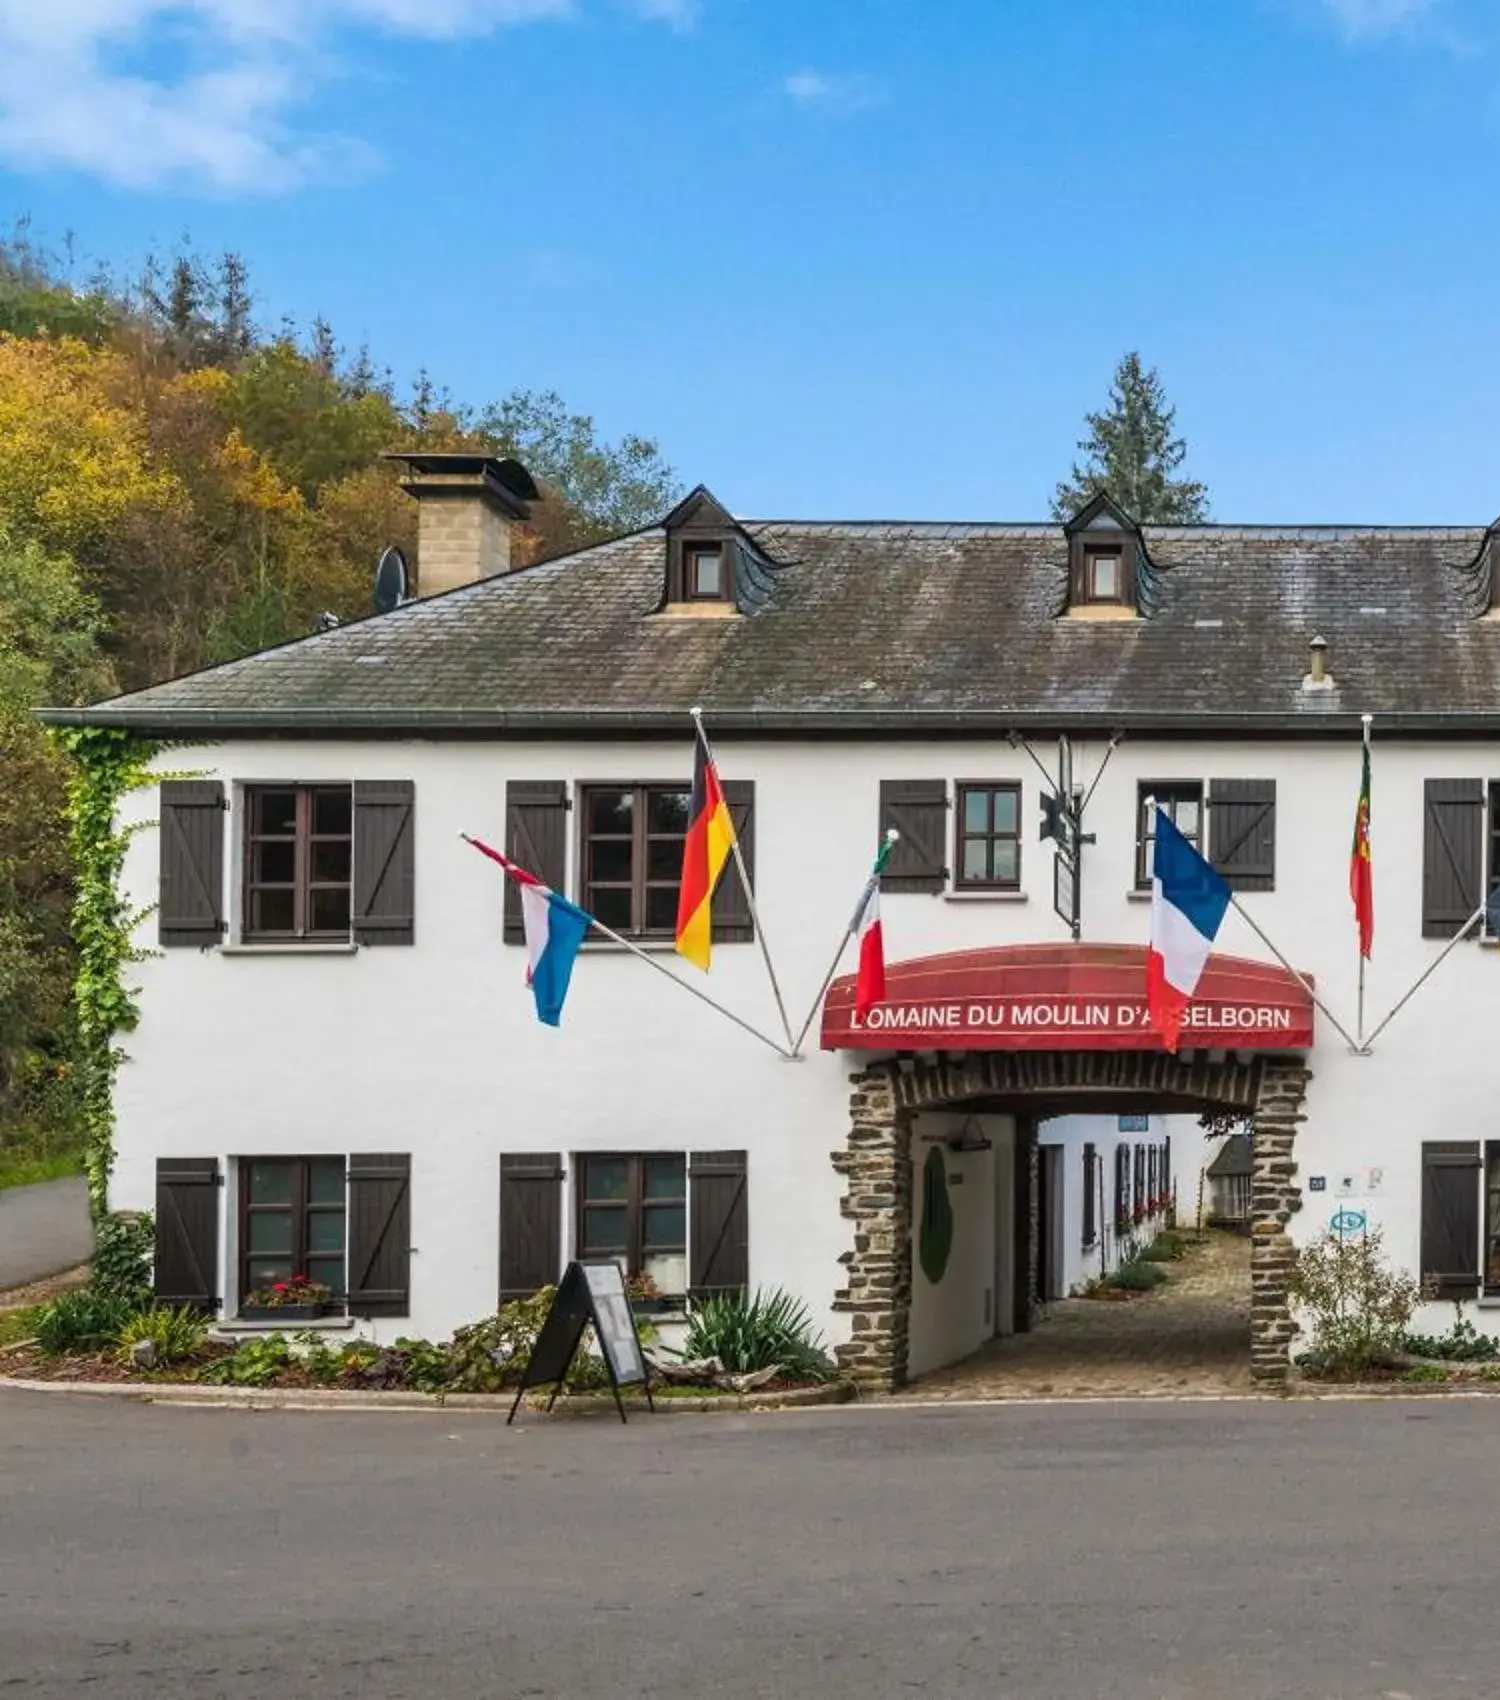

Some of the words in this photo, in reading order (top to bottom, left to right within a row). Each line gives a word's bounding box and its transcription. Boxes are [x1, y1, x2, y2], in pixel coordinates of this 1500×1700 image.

[967, 1005, 1004, 1025] DU
[1011, 1005, 1109, 1025] MOULIN
[1117, 1006, 1290, 1028] D'ASELBORN
